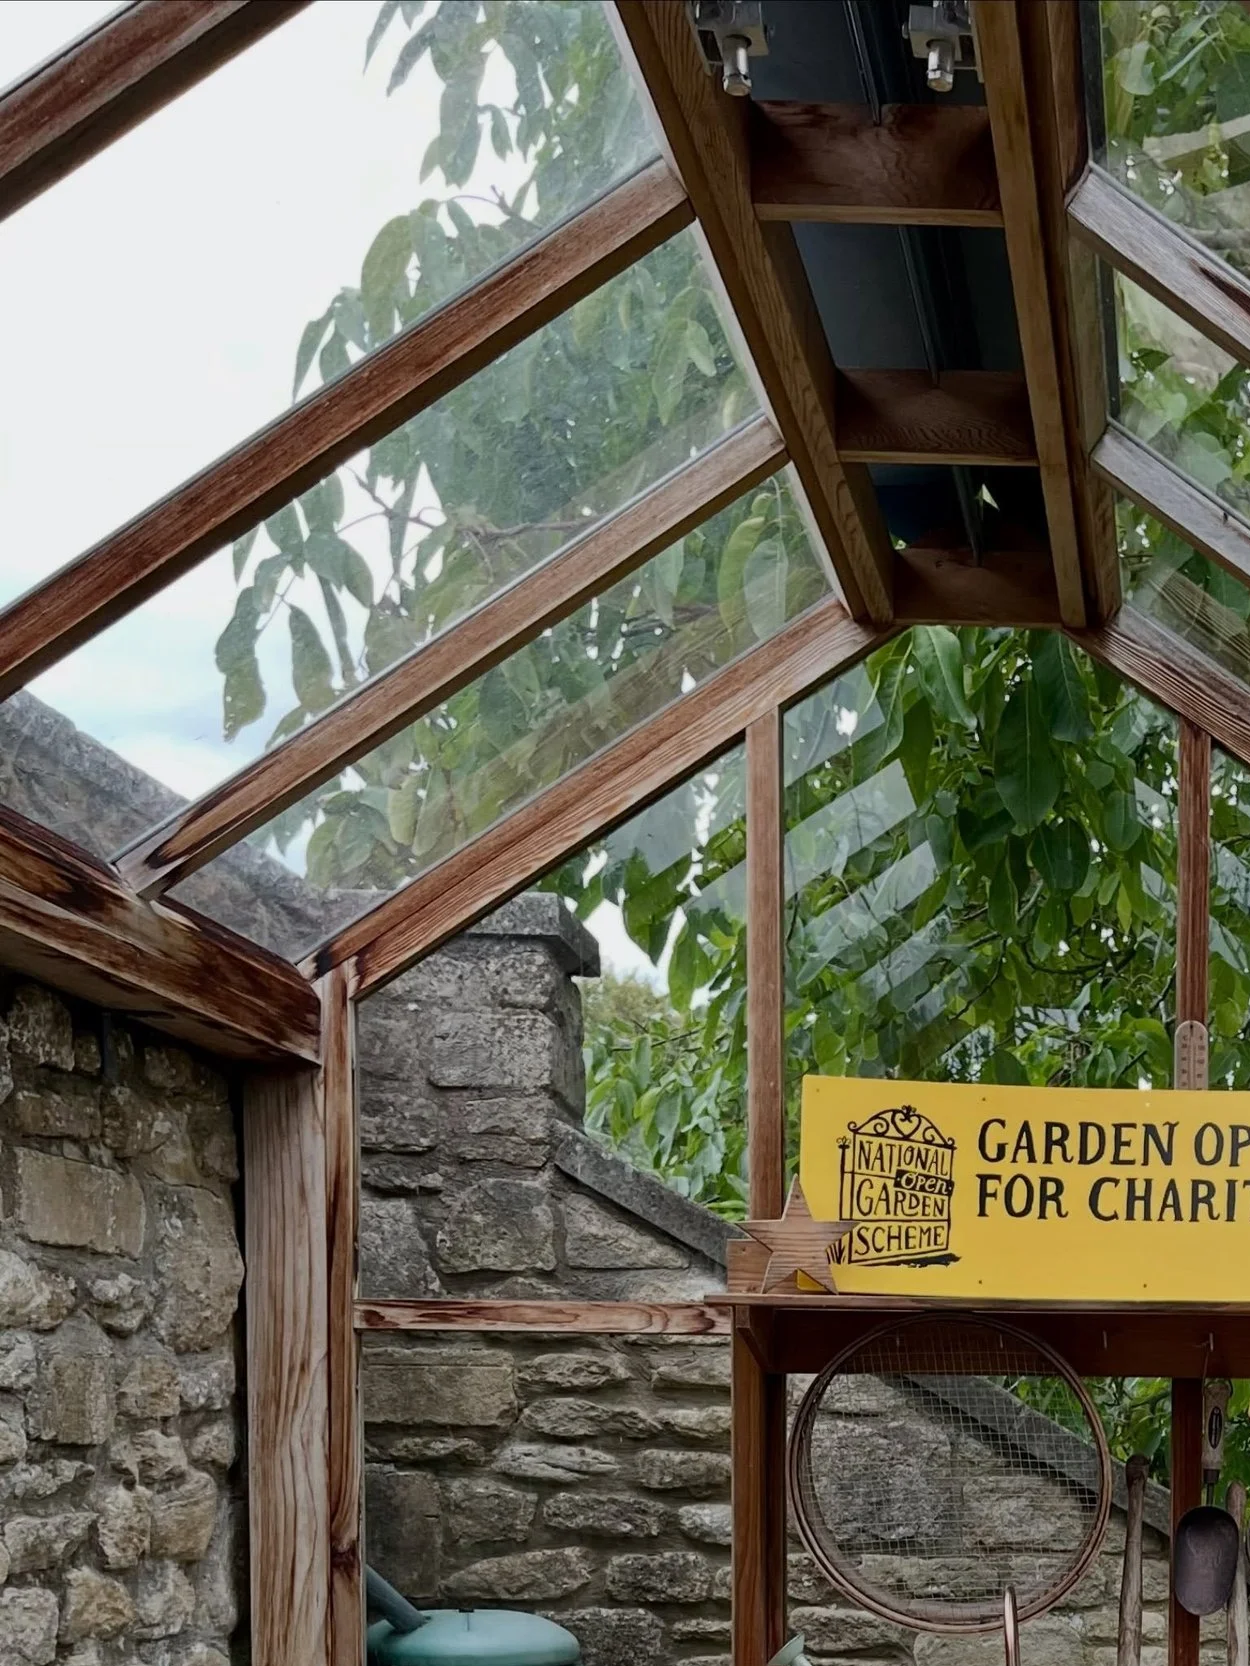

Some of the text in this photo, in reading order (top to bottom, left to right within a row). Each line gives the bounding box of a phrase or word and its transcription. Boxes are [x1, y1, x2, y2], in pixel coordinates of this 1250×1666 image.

[857, 1139, 949, 1177] NATIONAL
[977, 1118, 1180, 1167] GARDEN
[856, 1178, 947, 1217] GARDEN
[975, 1173, 1070, 1220] FOR
[854, 1224, 946, 1256] SCHEME
